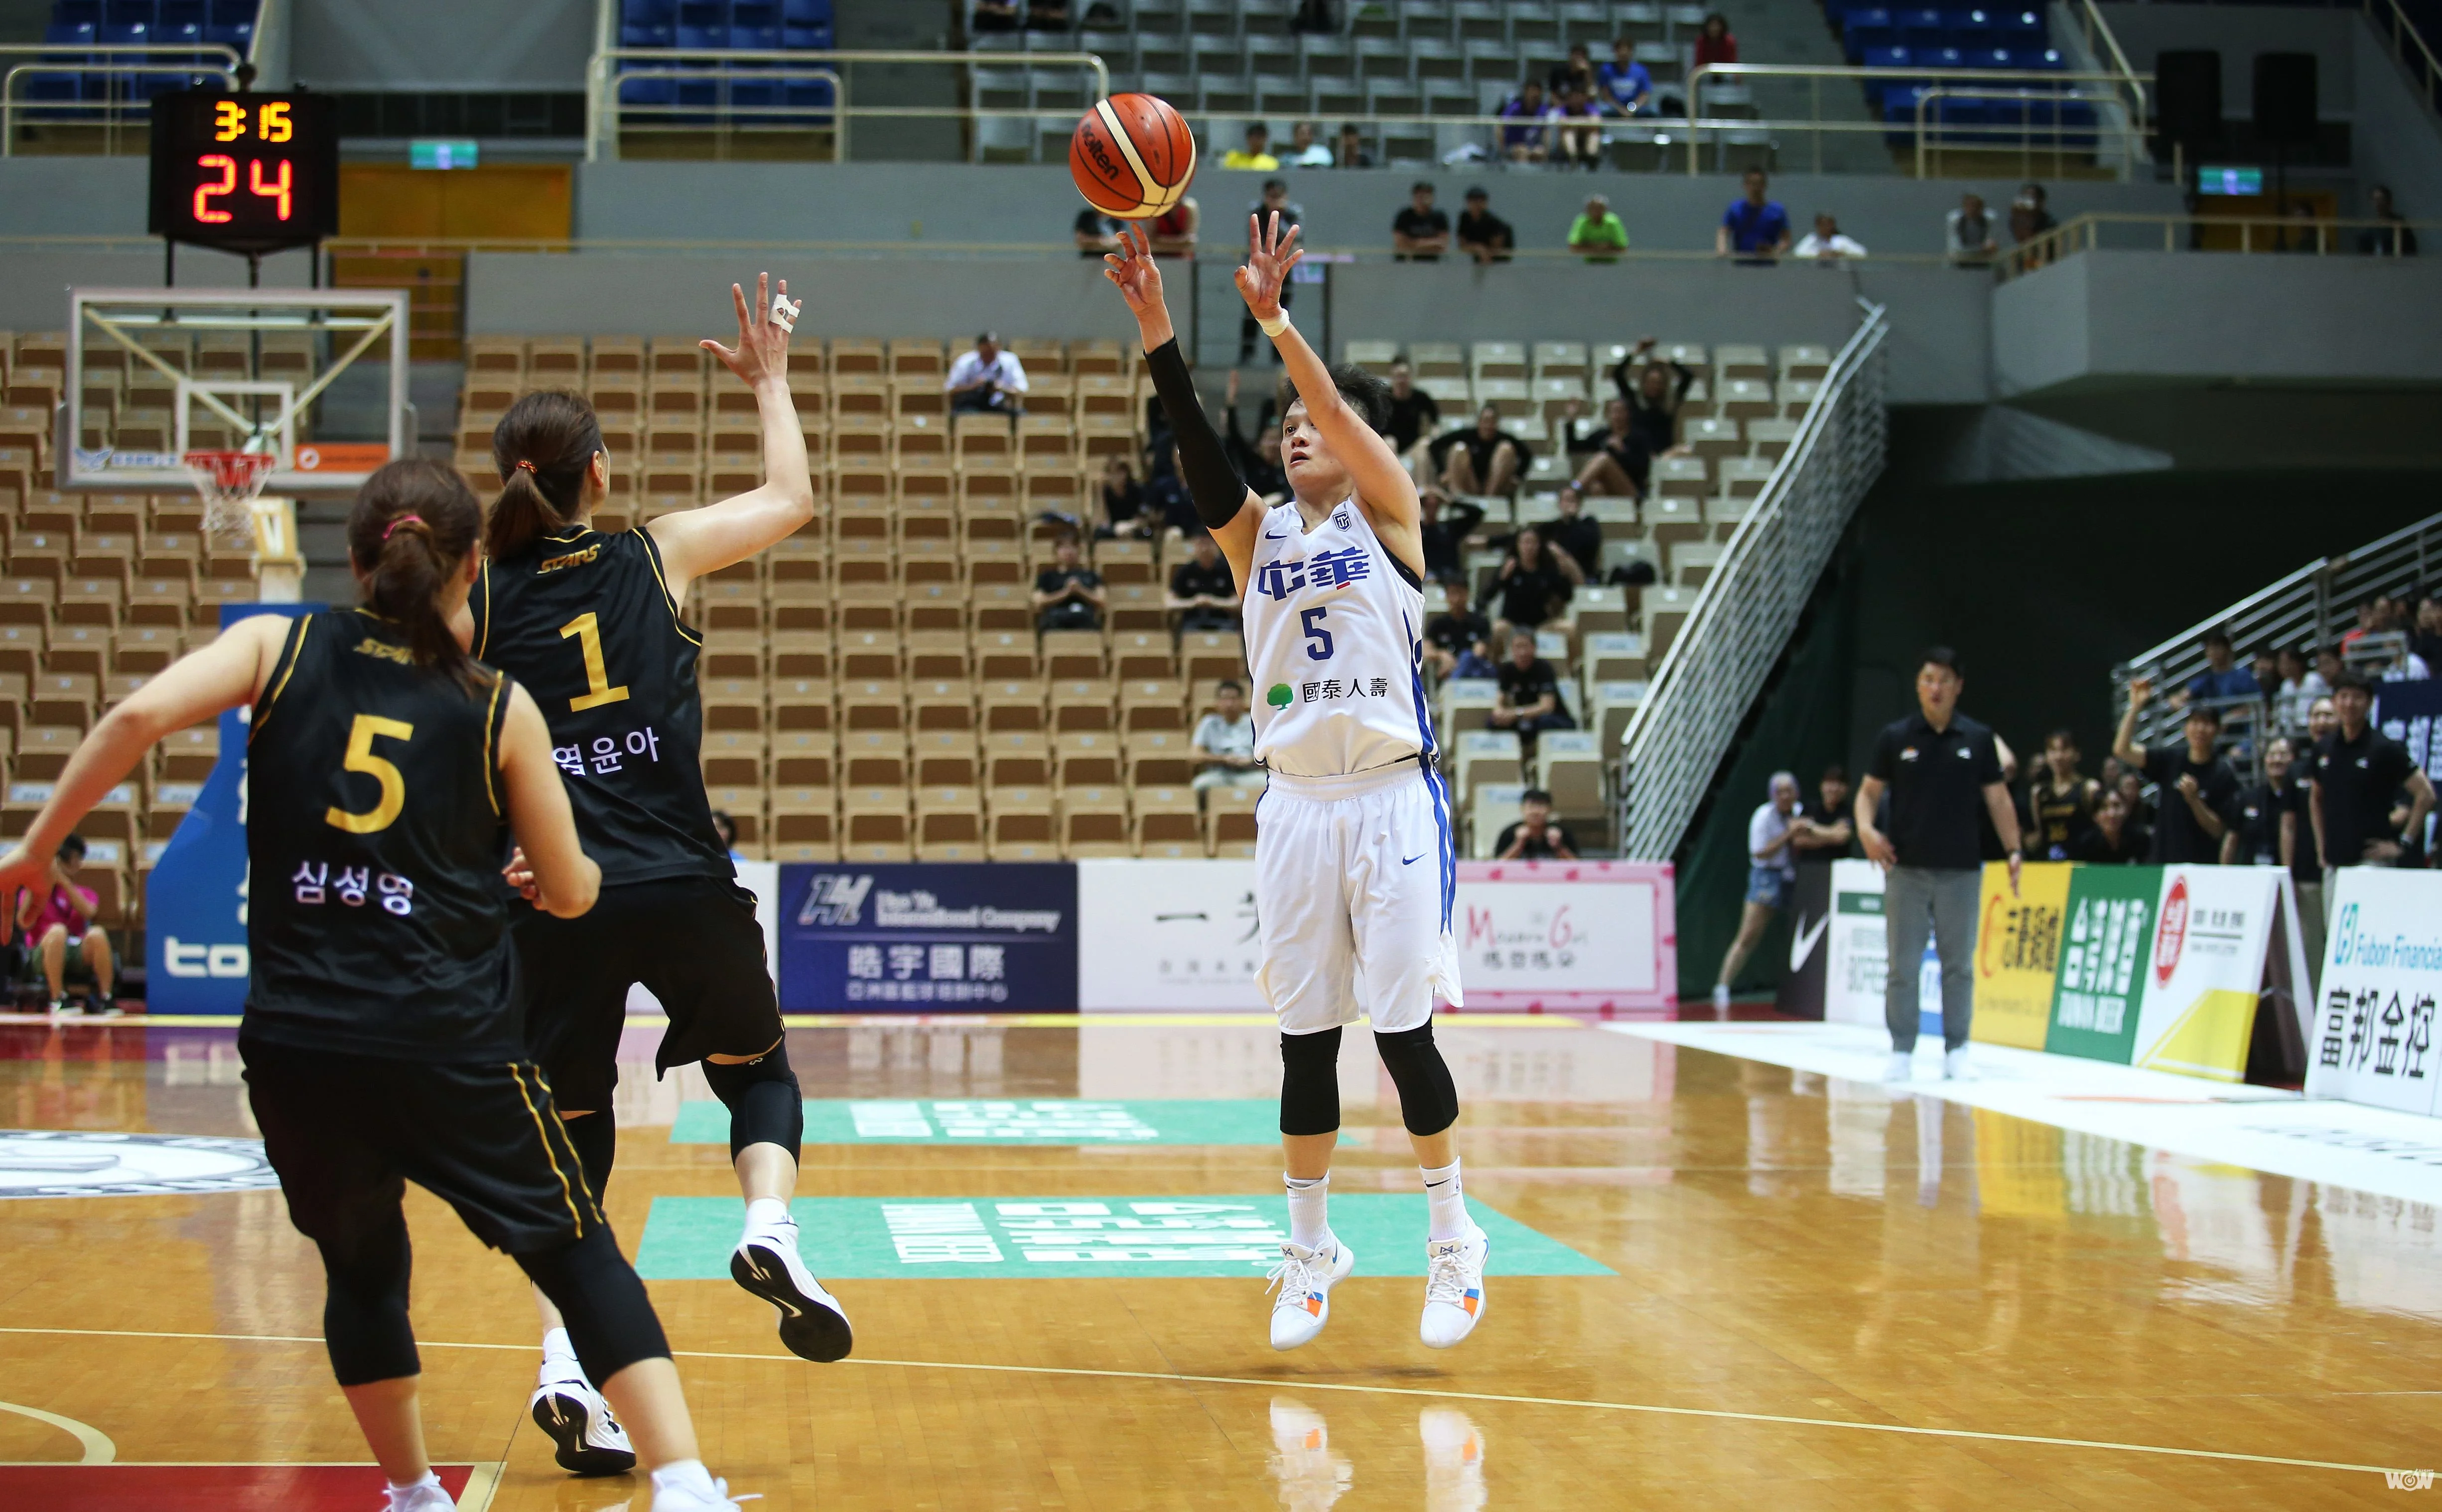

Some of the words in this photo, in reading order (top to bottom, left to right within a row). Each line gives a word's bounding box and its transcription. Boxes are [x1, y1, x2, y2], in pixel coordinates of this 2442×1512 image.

[214, 101, 293, 142] 3:15
[193, 154, 293, 224] 24
[536, 543, 602, 574] STARS
[1257, 546, 1370, 601] 中華
[1300, 606, 1334, 661] 5
[559, 612, 630, 713] 1
[1302, 677, 1388, 703] 國泰人壽
[325, 714, 414, 834] 5
[292, 860, 414, 917] 심성영
[2354, 932, 2391, 966] Fubon
[2318, 984, 2436, 1081] 富邦金控
